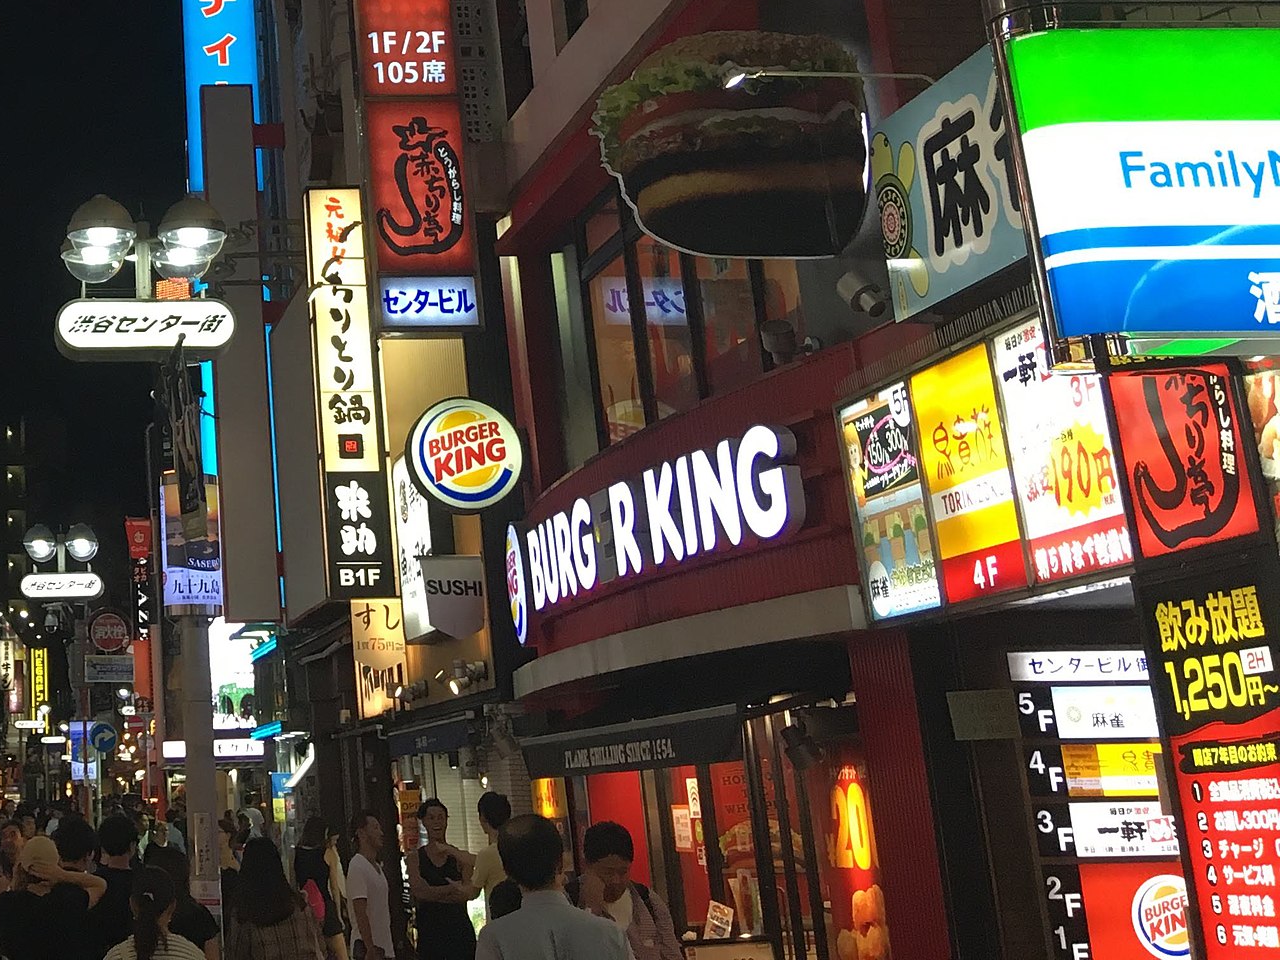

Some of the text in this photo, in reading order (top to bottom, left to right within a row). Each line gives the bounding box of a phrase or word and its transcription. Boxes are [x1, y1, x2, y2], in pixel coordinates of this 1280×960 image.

[373, 60, 446, 84] 105席
[1119, 149, 1280, 200] Family
[383, 289, 475, 315] センタービル
[70, 314, 227, 335] 渋谷センター街
[428, 420, 500, 459] BURGER
[433, 443, 506, 485] KING
[642, 424, 790, 567] KING
[340, 568, 380, 586] B1F
[973, 556, 998, 588] 4F
[427, 578, 483, 598] SUSHI
[355, 604, 400, 631] すし
[1155, 586, 1265, 651] 飲み放題
[1246, 651, 1266, 669] 2H
[1092, 713, 1125, 729] 麻雀
[626, 741, 651, 763] SINCE
[834, 783, 872, 871] 20
[1219, 839, 1263, 858] チャージ
[1144, 896, 1190, 922] BURGE
[1149, 909, 1187, 941] KIN
